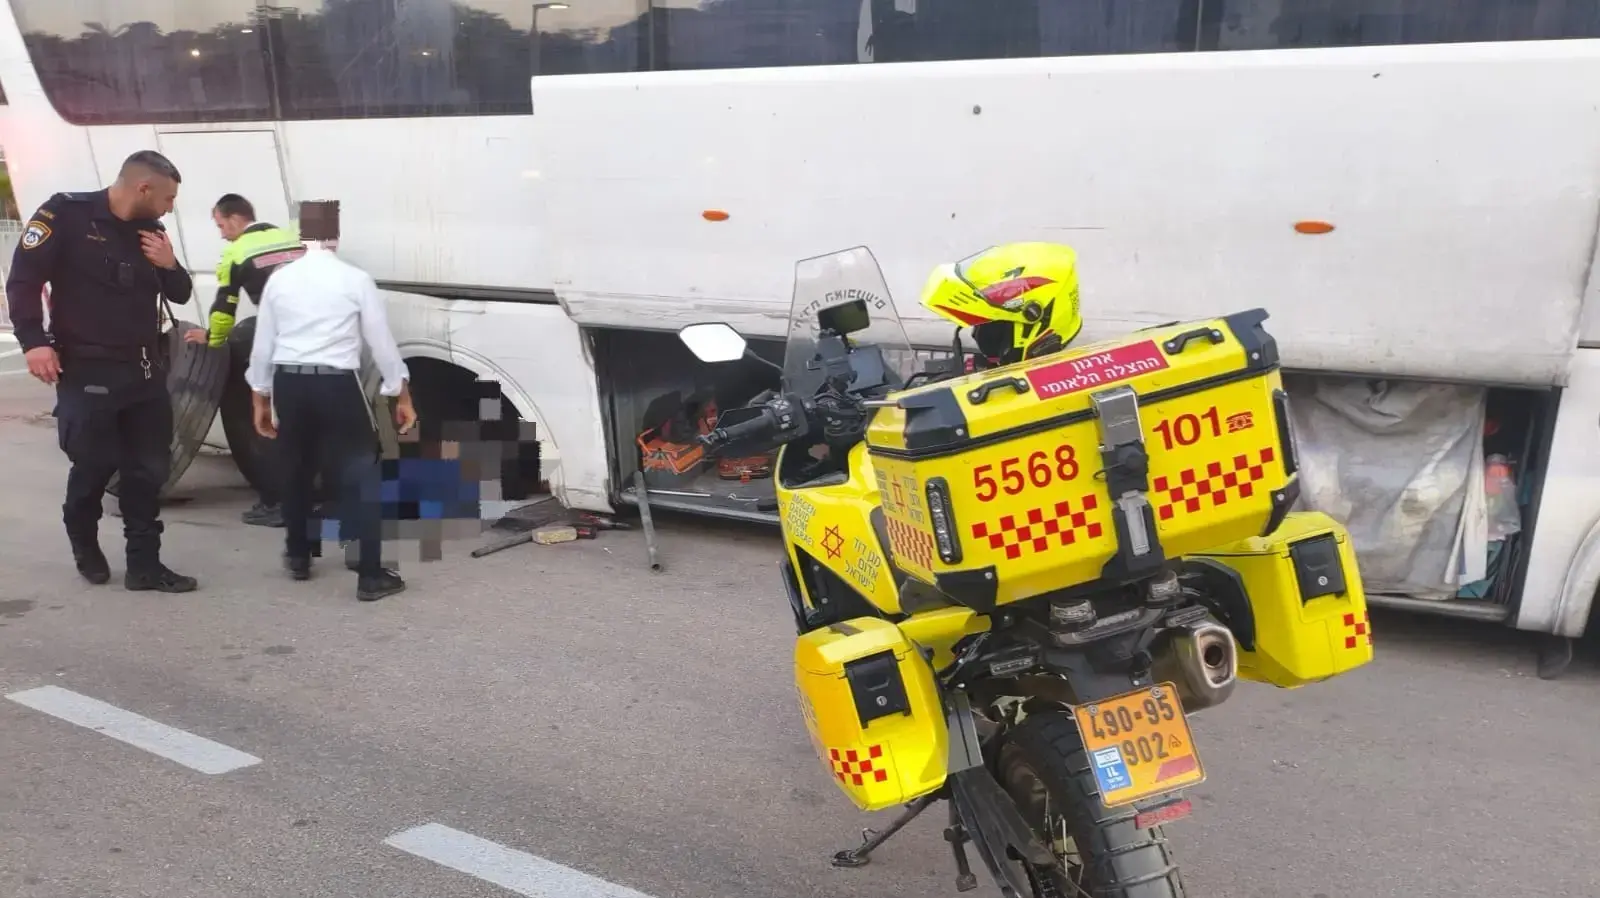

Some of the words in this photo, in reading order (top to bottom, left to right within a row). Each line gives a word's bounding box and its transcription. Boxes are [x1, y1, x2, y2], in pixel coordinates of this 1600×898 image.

[1071, 352, 1114, 372] ארגון
[1104, 357, 1161, 379] ההצלה
[1040, 373, 1102, 394] הלאומי
[1152, 405, 1222, 451] 101
[973, 444, 1080, 502] 5568
[1122, 732, 1169, 766] 902
